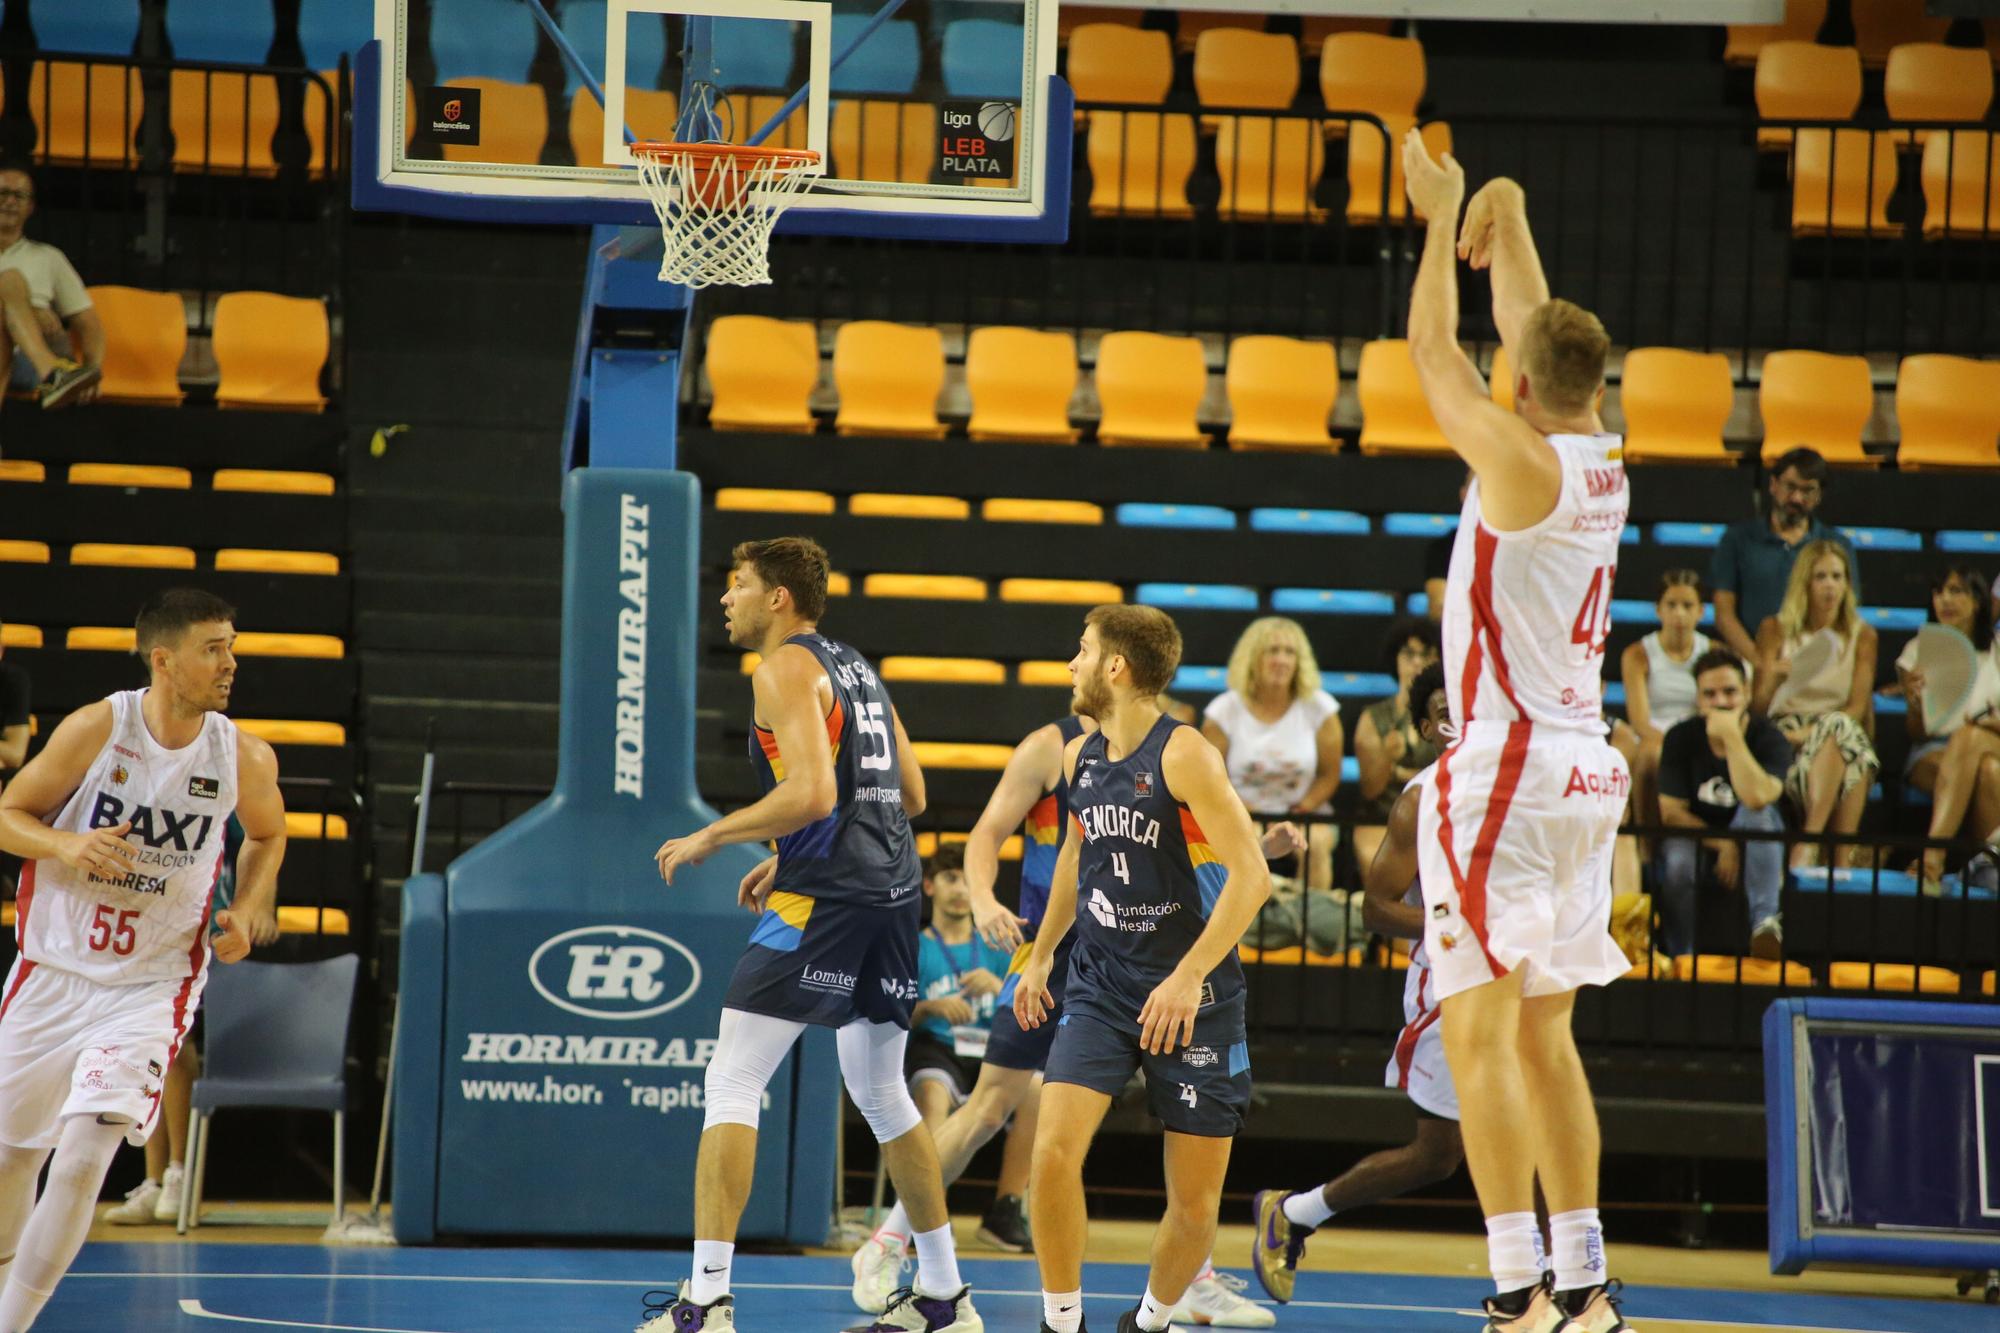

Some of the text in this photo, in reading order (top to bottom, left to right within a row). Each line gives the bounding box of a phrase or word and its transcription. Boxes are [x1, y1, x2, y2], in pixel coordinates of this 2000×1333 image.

[943, 111, 972, 128] Liga
[943, 137, 986, 156] LEB
[942, 157, 1001, 173] PLATA
[614, 494, 650, 799] HORMIRAPIT
[853, 701, 892, 771] 55
[89, 791, 213, 851] BAXI
[1111, 852, 1130, 885] 4
[1116, 902, 1181, 917] Fundación
[89, 903, 140, 955] 55
[1120, 920, 1157, 932] Hestia
[461, 1033, 720, 1068] HORMIRAP
[1179, 1082, 1197, 1108] 4
